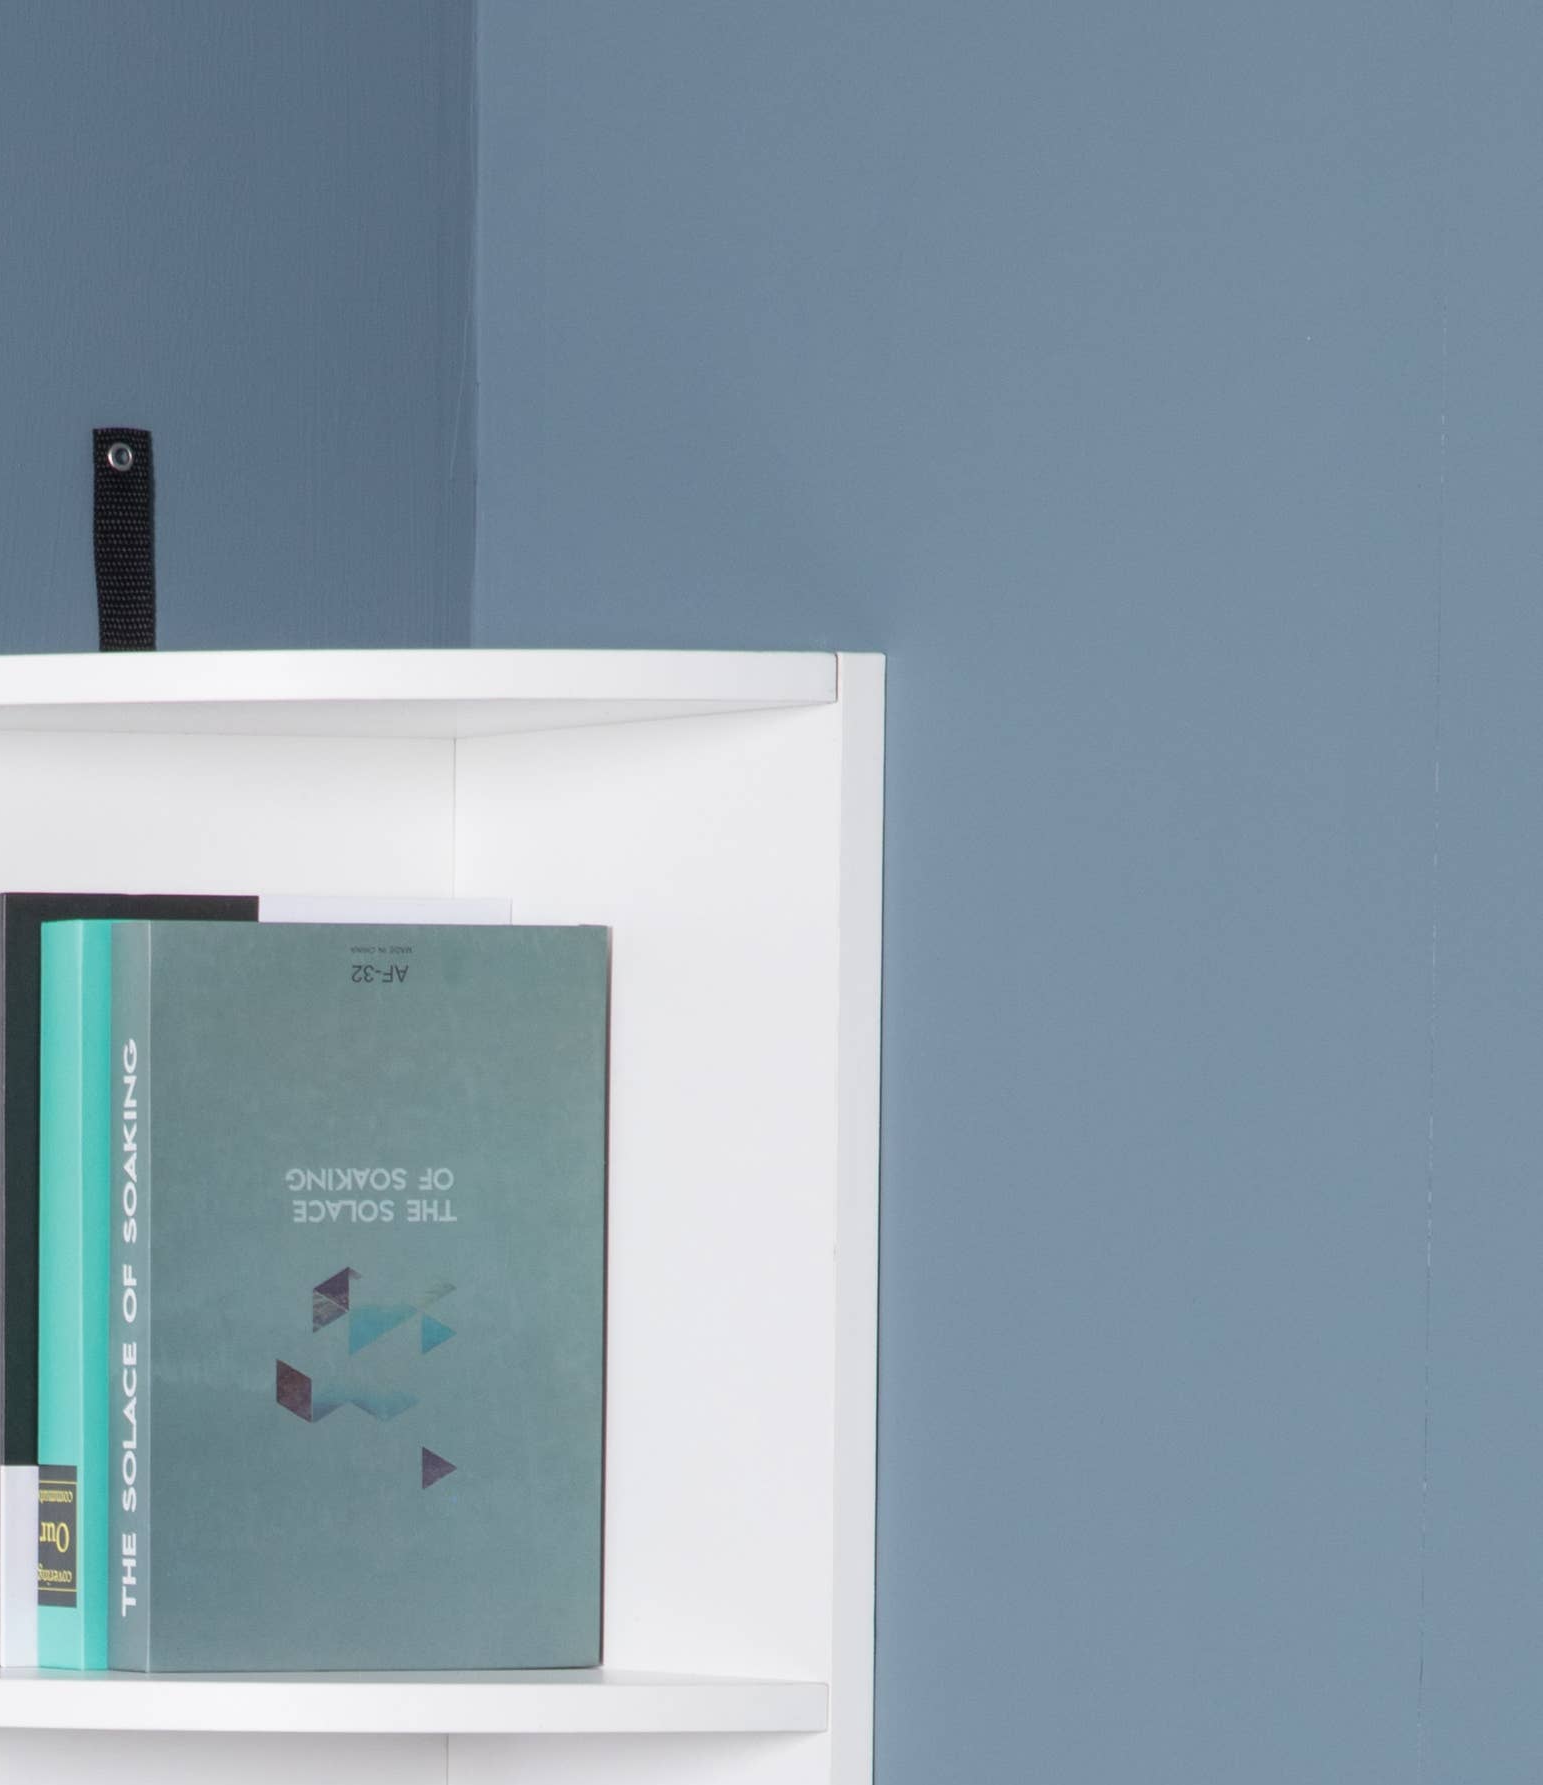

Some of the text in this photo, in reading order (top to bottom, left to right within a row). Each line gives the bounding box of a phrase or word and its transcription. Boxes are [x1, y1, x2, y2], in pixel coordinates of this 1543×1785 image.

[351, 964, 409, 983] AF-32
[284, 1168, 455, 1191] OF SOAKING
[292, 1200, 458, 1223] THE SOLACE
[120, 1038, 139, 1616] THE SOLACE OF SOAKING
[39, 1521, 70, 1553] Our
